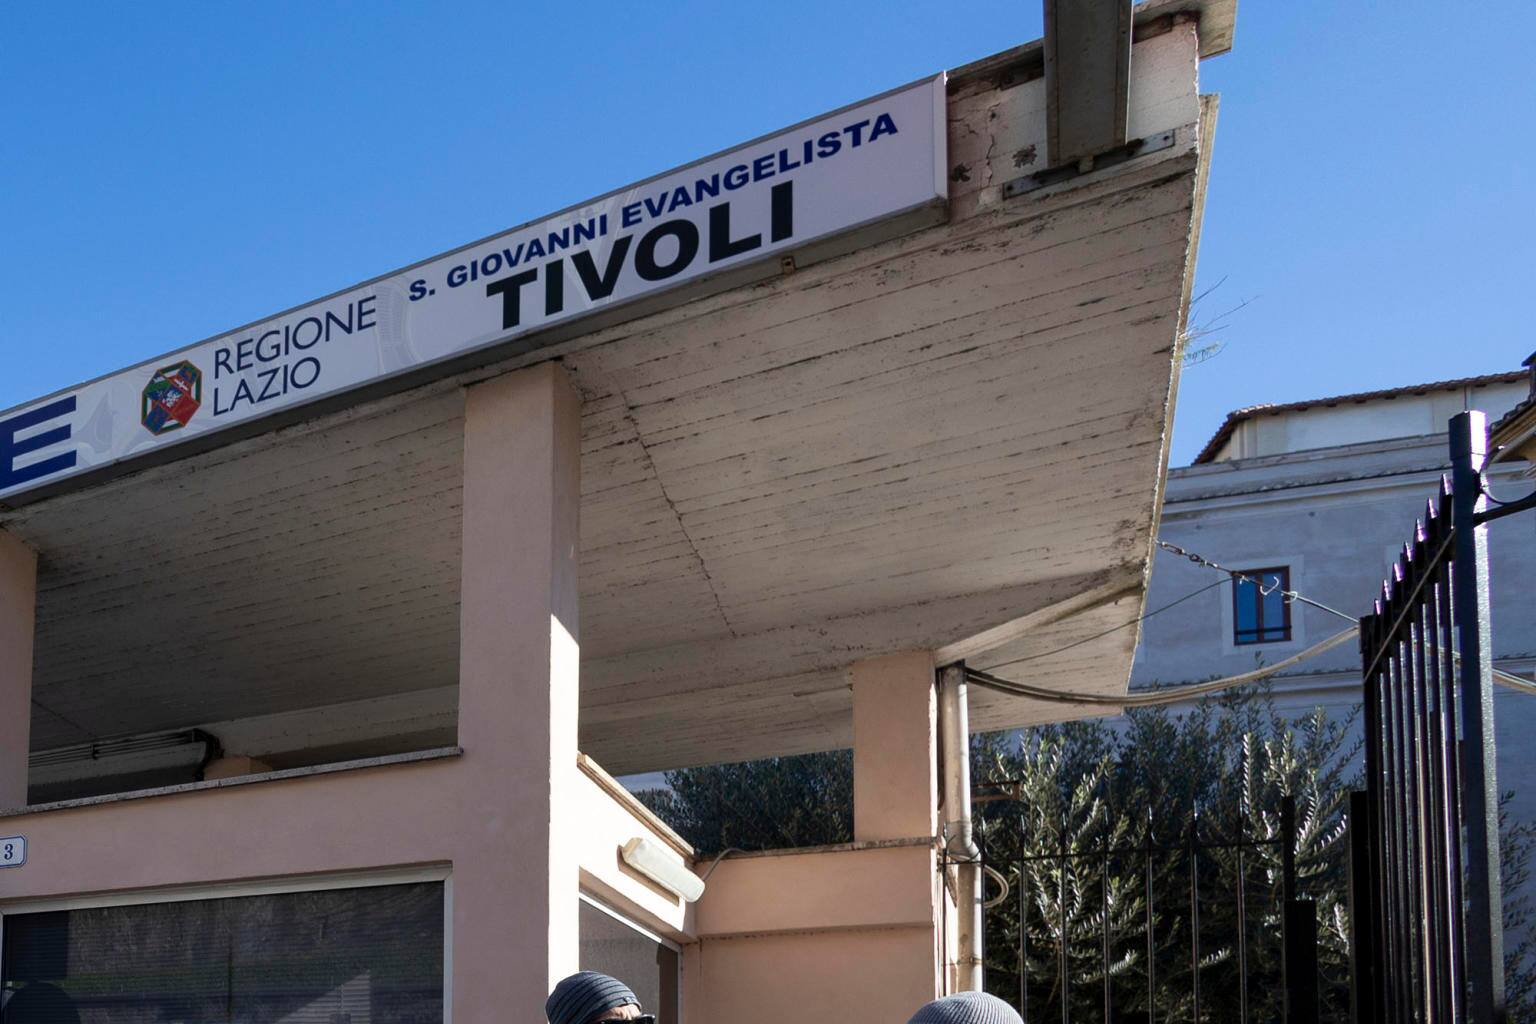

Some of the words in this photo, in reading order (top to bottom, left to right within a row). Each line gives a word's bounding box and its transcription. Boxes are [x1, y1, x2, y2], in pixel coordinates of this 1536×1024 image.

[407, 275, 436, 303] S.
[446, 213, 610, 288] GIOVANNI
[622, 111, 900, 227] EVANGELISTA
[486, 179, 795, 331] TIVOLI
[213, 295, 377, 378] REGIONE
[213, 356, 322, 418] LAZIO
[4, 843, 14, 860] 3
